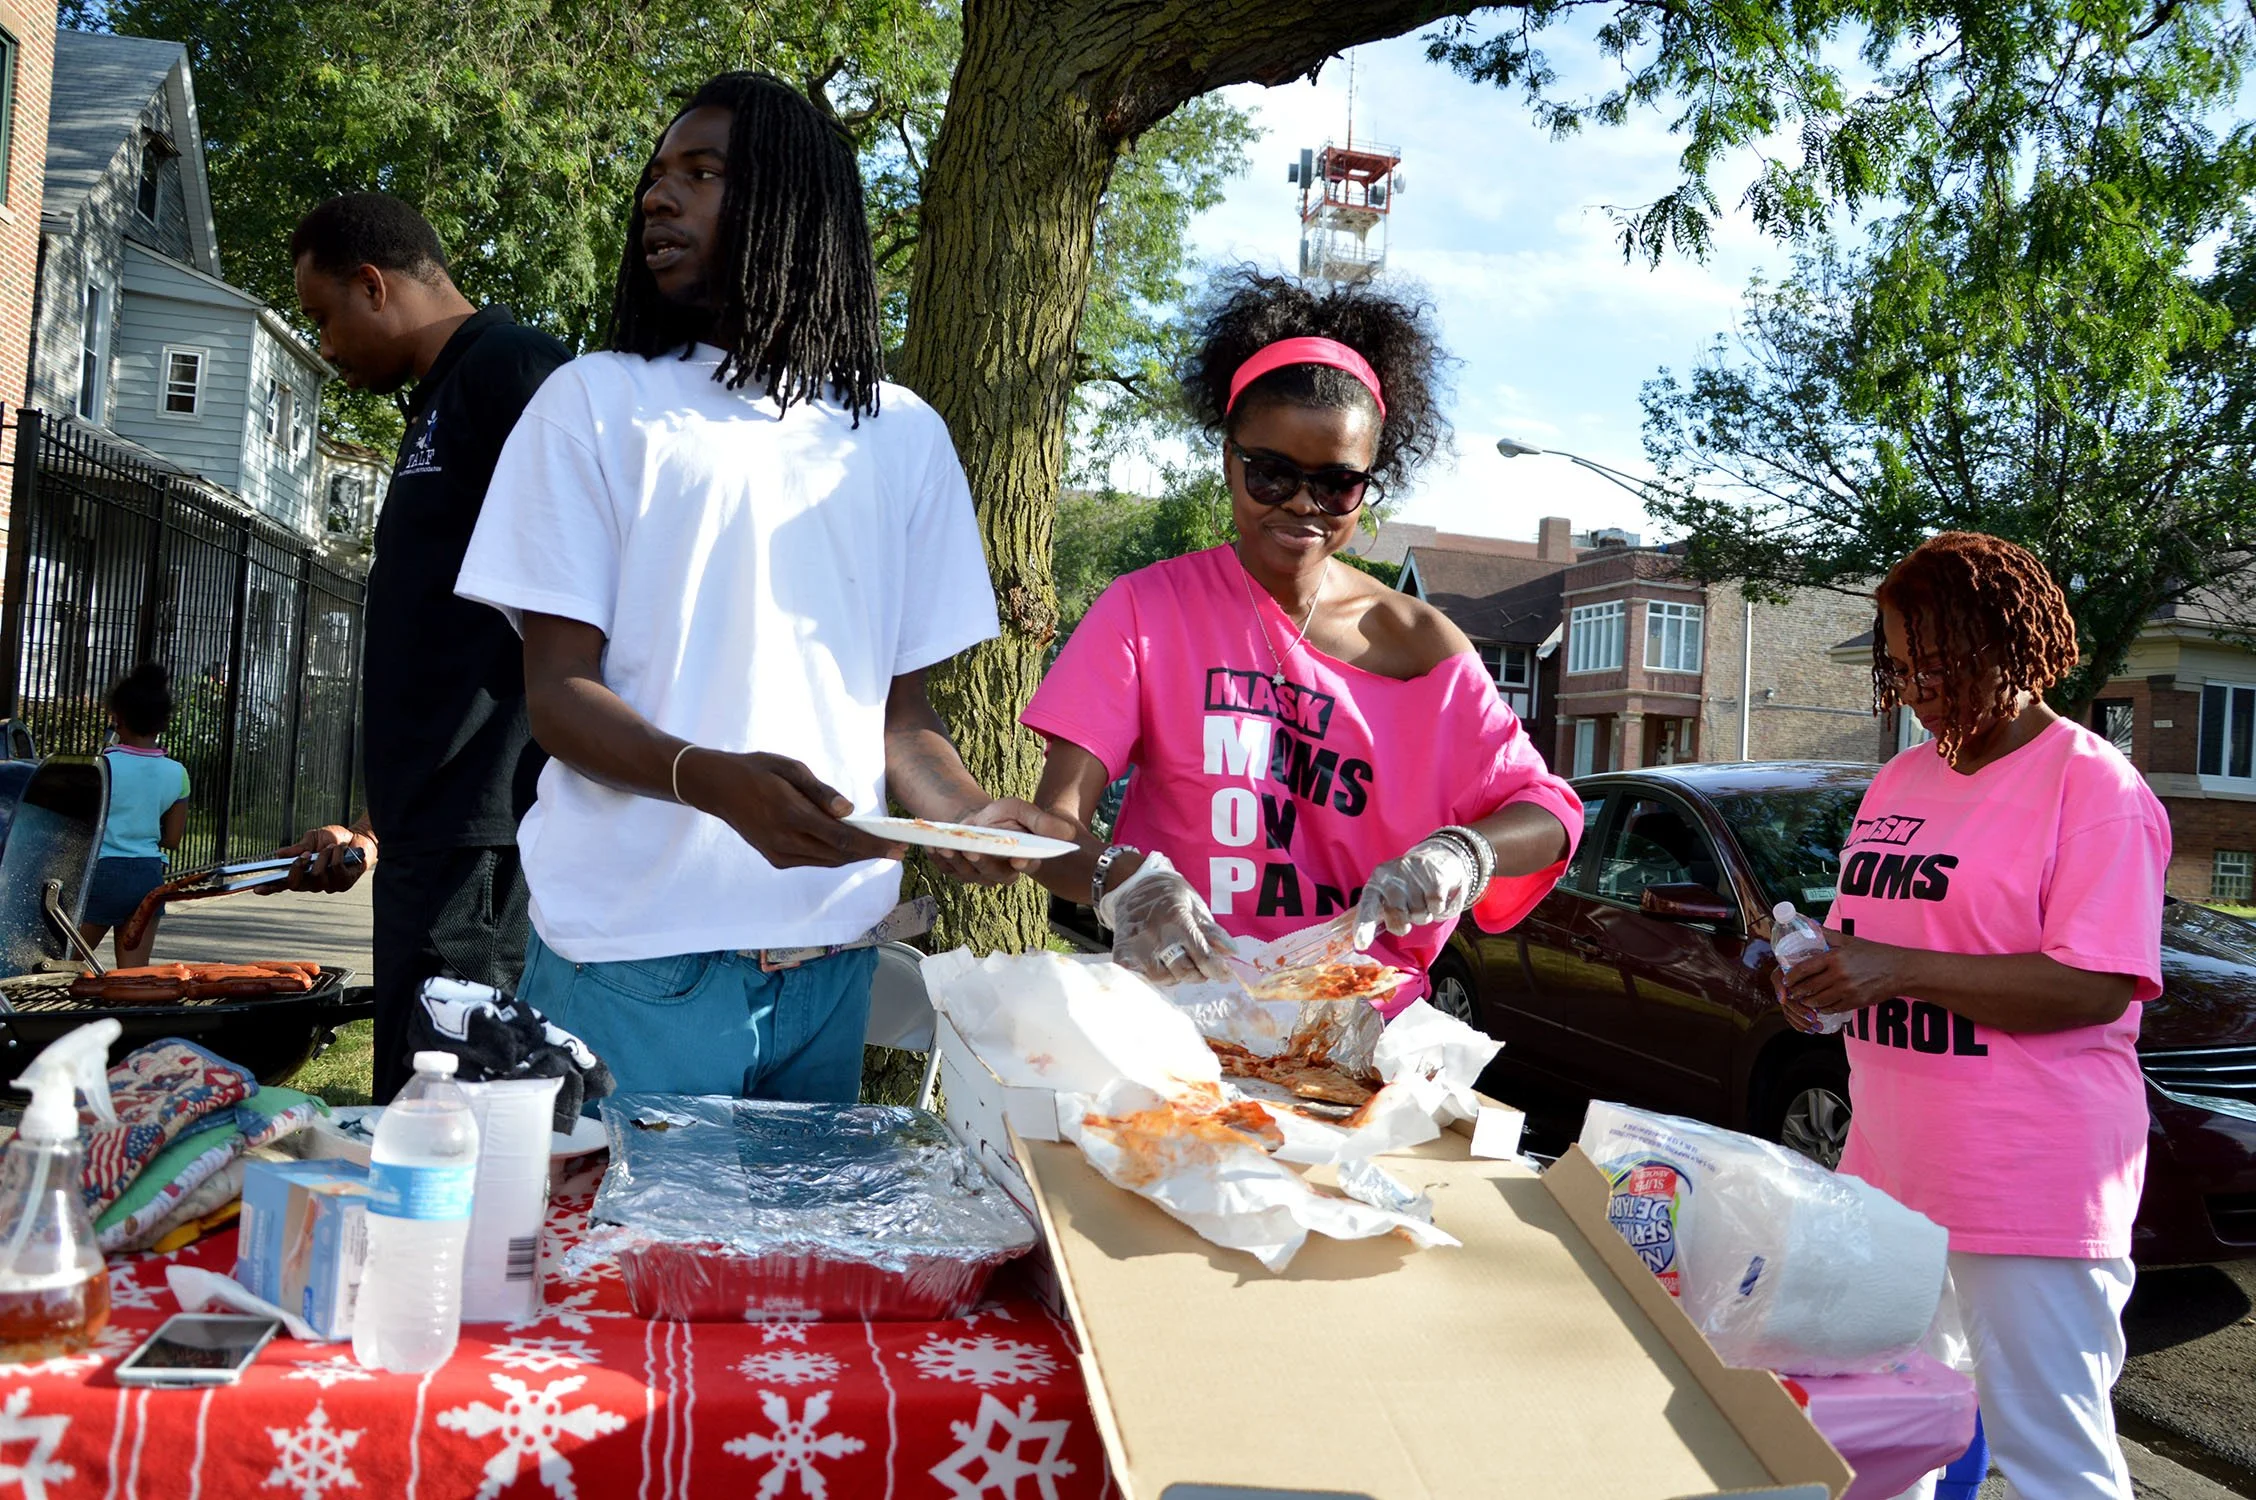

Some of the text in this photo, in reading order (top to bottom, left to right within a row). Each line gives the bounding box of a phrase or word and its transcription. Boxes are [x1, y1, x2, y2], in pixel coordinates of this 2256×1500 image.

[1205, 668, 1335, 740] MASK
[1203, 715, 1373, 818] MOMS
[1841, 851, 1959, 902] OMS
